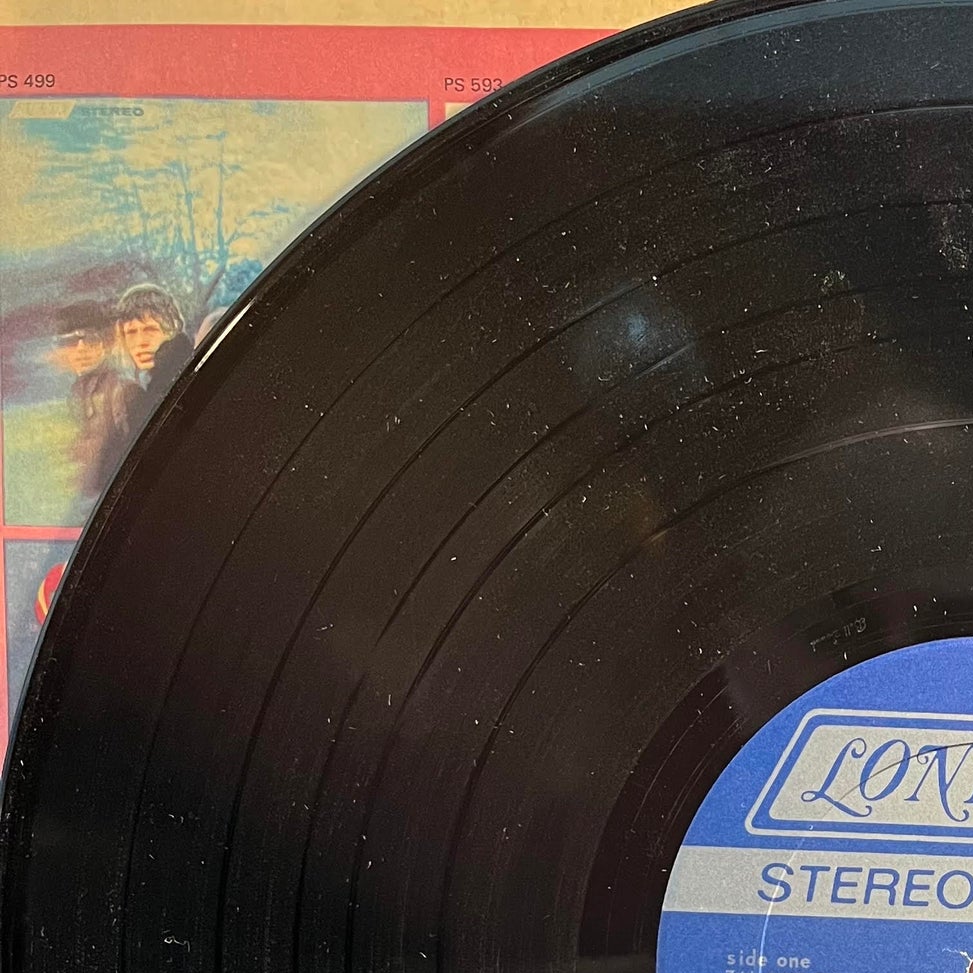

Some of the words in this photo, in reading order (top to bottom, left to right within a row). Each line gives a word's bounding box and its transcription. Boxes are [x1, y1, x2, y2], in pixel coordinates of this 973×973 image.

[24, 74, 55, 88] 499
[444, 78, 465, 92] PS
[471, 78, 502, 92] 593
[727, 948, 767, 966] side
[776, 956, 811, 969] one
